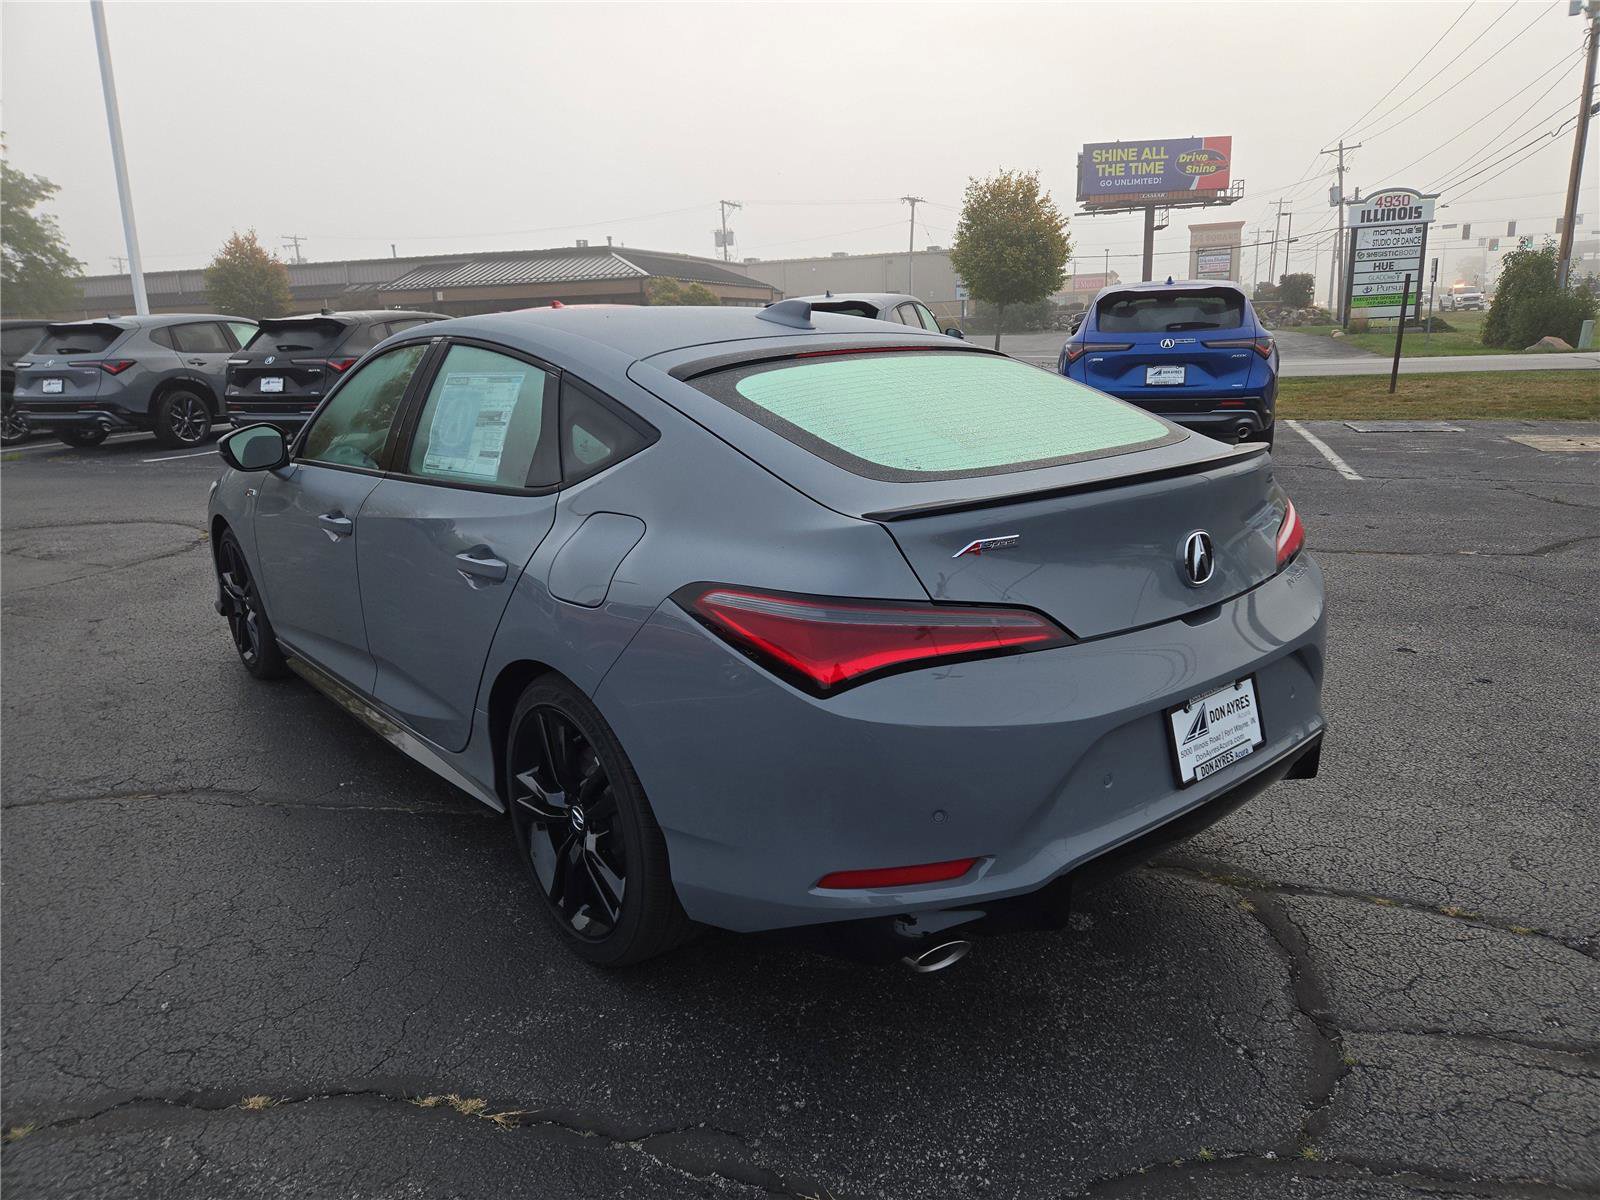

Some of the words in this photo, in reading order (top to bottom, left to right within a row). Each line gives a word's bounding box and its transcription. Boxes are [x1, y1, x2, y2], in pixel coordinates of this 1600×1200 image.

[1092, 147, 1138, 163] SHINE
[1141, 146, 1168, 161] ALL
[1179, 152, 1209, 163] Drive
[1096, 163, 1126, 177] THE
[1128, 161, 1164, 176] TIME
[1185, 163, 1216, 174] Shine
[1115, 177, 1162, 186] UNLIMITED!
[1375, 194, 1411, 208] 4930
[1360, 205, 1423, 223] ILLINOIS
[1372, 238, 1391, 247] STUDIO
[1392, 237, 1400, 246] OF
[1403, 236, 1421, 245] DANCE
[1373, 261, 1395, 271] HUE
[1376, 284, 1404, 292] Pursui
[1209, 704, 1227, 723] DON
[1227, 694, 1251, 715] AYRES
[1200, 762, 1216, 777] DON
[1214, 750, 1235, 770] AYRES
[1235, 747, 1249, 759] Acura
